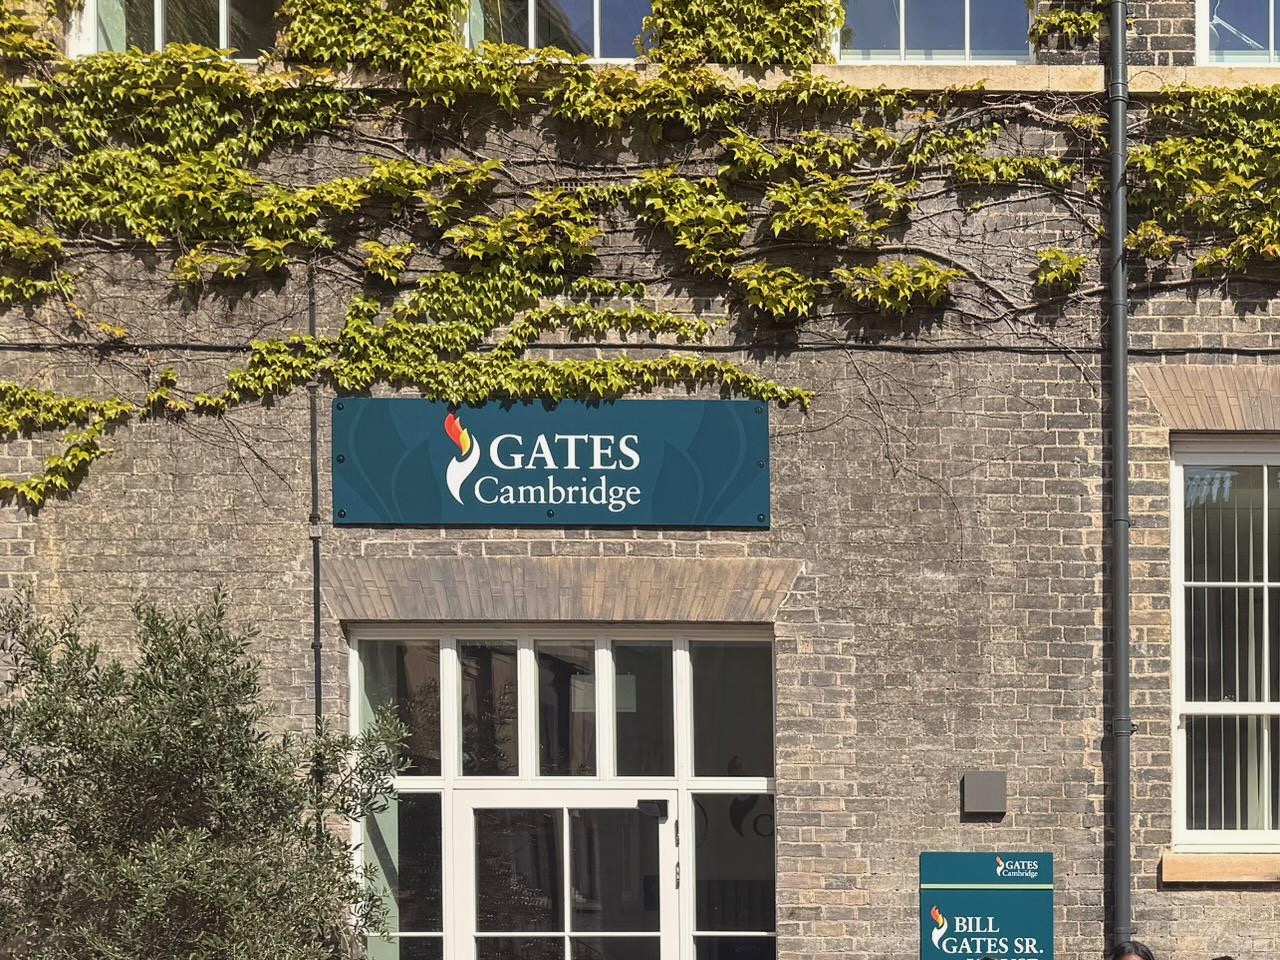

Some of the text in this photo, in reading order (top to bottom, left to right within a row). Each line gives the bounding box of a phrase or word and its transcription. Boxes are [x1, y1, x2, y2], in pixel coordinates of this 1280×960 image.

[489, 434, 641, 471] GATES
[474, 476, 641, 512] Cambridge
[1005, 860, 1039, 870] GATES
[1002, 869, 1039, 879] Cambridge
[954, 916, 1000, 933] BILL
[942, 937, 1044, 954] GATES SR.
